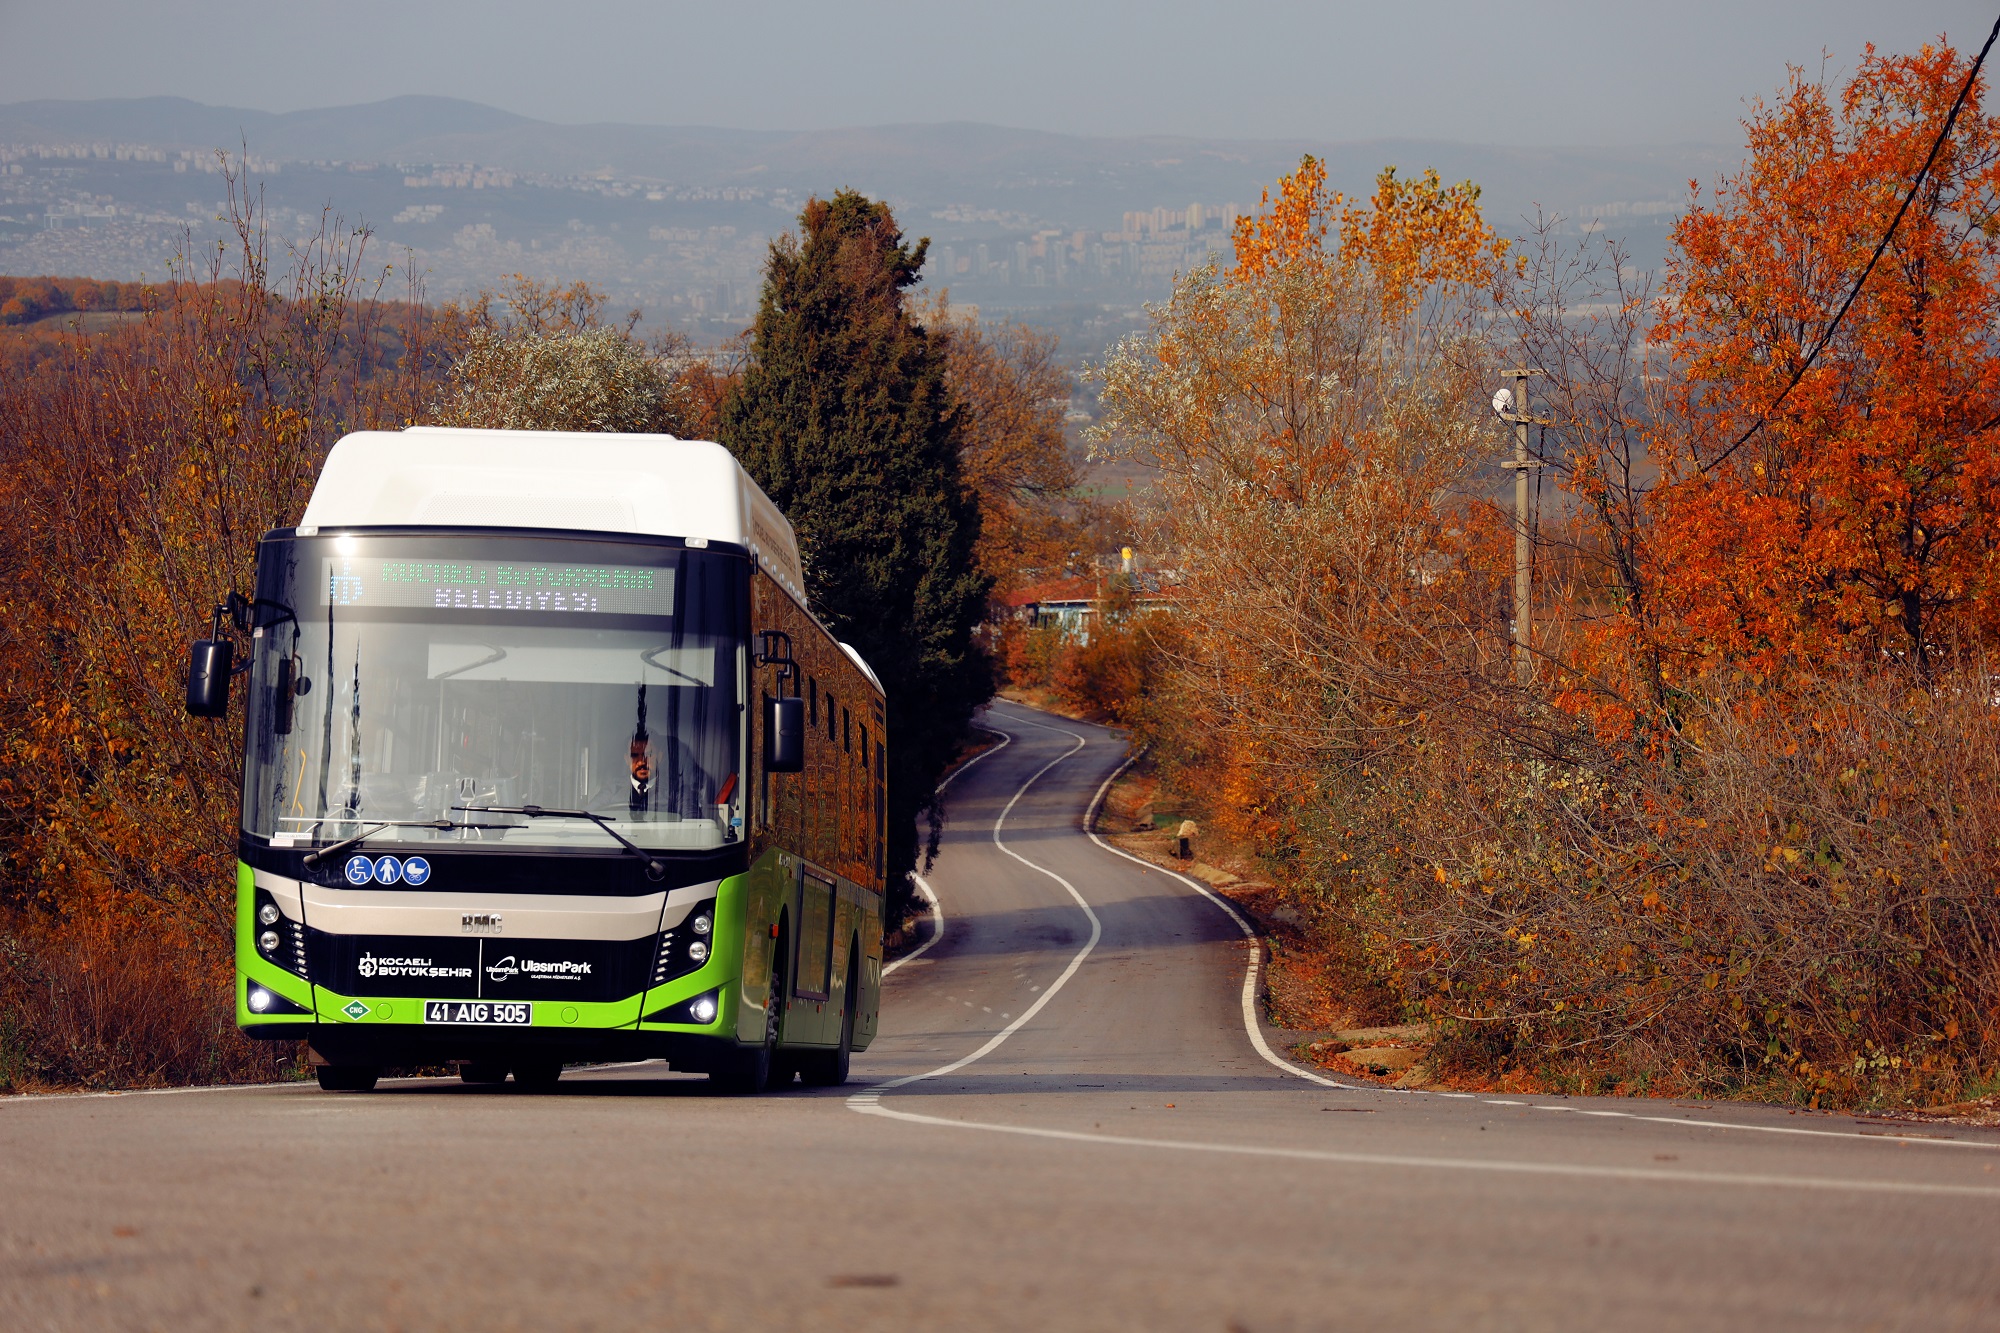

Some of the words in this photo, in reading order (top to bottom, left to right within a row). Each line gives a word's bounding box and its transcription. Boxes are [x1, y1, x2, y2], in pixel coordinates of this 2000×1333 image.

[461, 913, 503, 934] BMC
[379, 957, 432, 966] KOCAELİ
[379, 966, 472, 978] BÜYÜKŞEHİR
[350, 1006, 363, 1014] CNG
[430, 1003, 448, 1021] 41
[455, 1004, 488, 1022] AIG
[493, 1005, 526, 1023] 505
